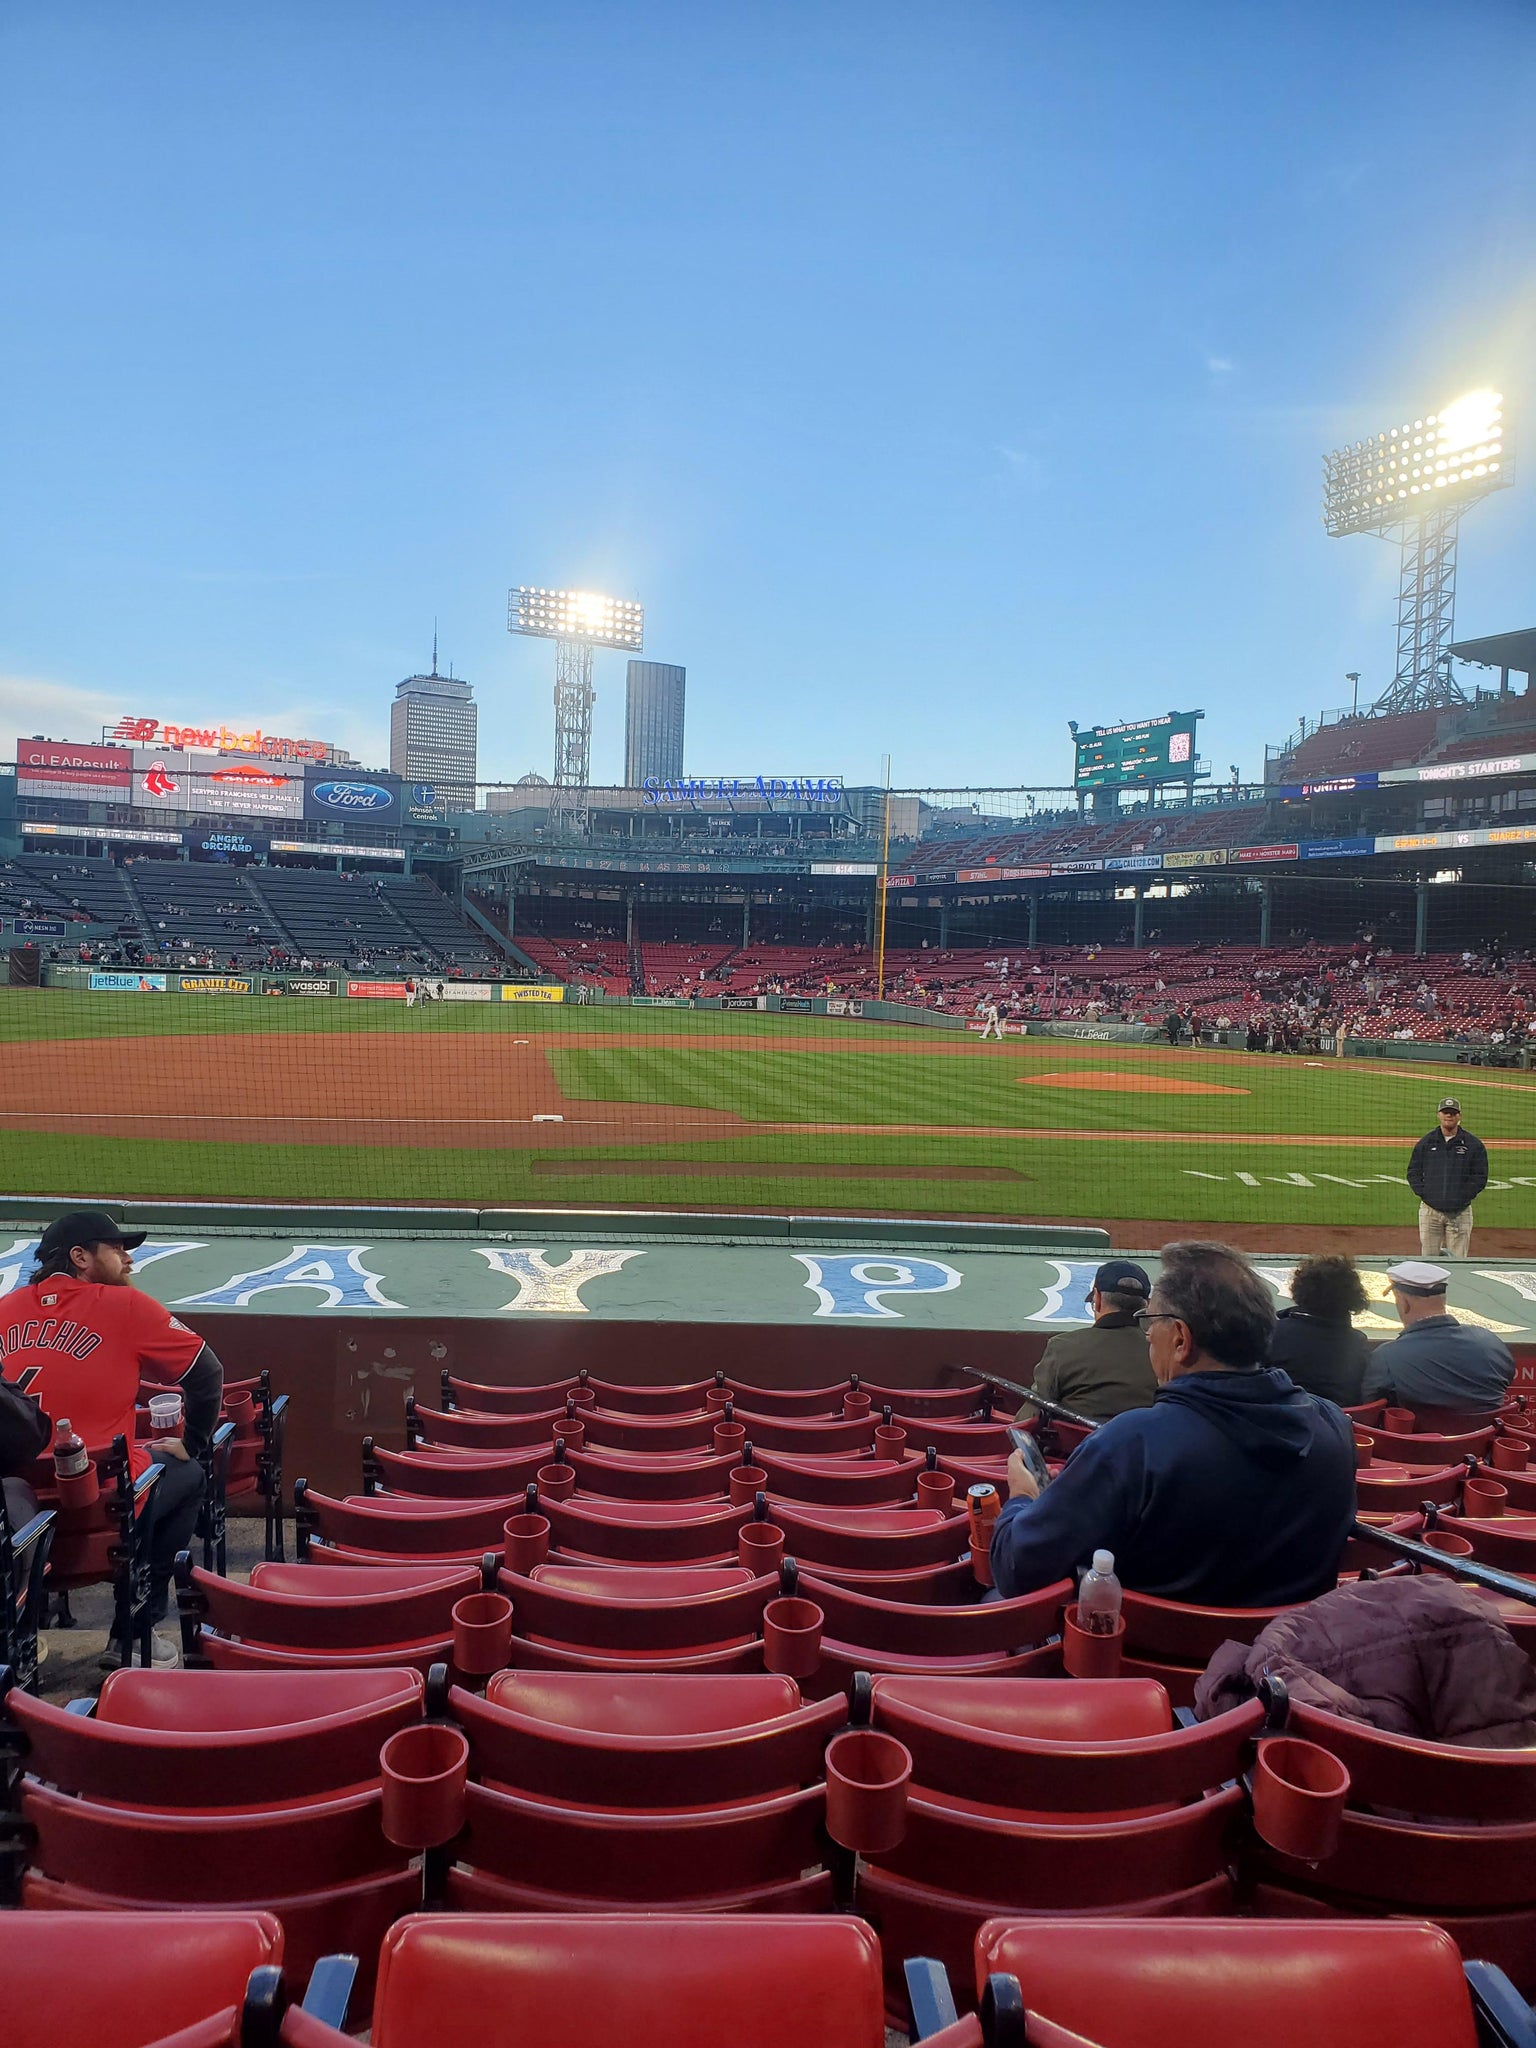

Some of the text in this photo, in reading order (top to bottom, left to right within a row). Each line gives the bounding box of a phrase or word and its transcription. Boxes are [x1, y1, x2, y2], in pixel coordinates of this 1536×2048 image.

[1112, 726, 1126, 734] WHAT
[1136, 722, 1150, 730] WANT
[1158, 717, 1172, 726] HEAR
[164, 725, 328, 759] new balance
[29, 754, 120, 770] CLEAResult
[1417, 758, 1522, 781] TONIGHT'S STARTERS
[192, 788, 220, 796] SERVPRO
[328, 784, 378, 807] Ford
[643, 775, 842, 806] SAMUEL ADAMS
[232, 802, 252, 810] NEVER
[408, 806, 434, 814] Johnson
[412, 812, 438, 820] Controls
[209, 834, 245, 844] ANGRY
[1457, 834, 1470, 844] VS
[1488, 830, 1522, 842] SUAREZ
[201, 841, 253, 852] ORCHARD
[718, 864, 730, 872] 42
[970, 871, 988, 880] STIHL
[94, 976, 134, 988] jetBlue
[181, 978, 250, 992] GRANITE CITY
[290, 980, 330, 991] wasabi
[513, 990, 552, 1000] TWISTED TEA
